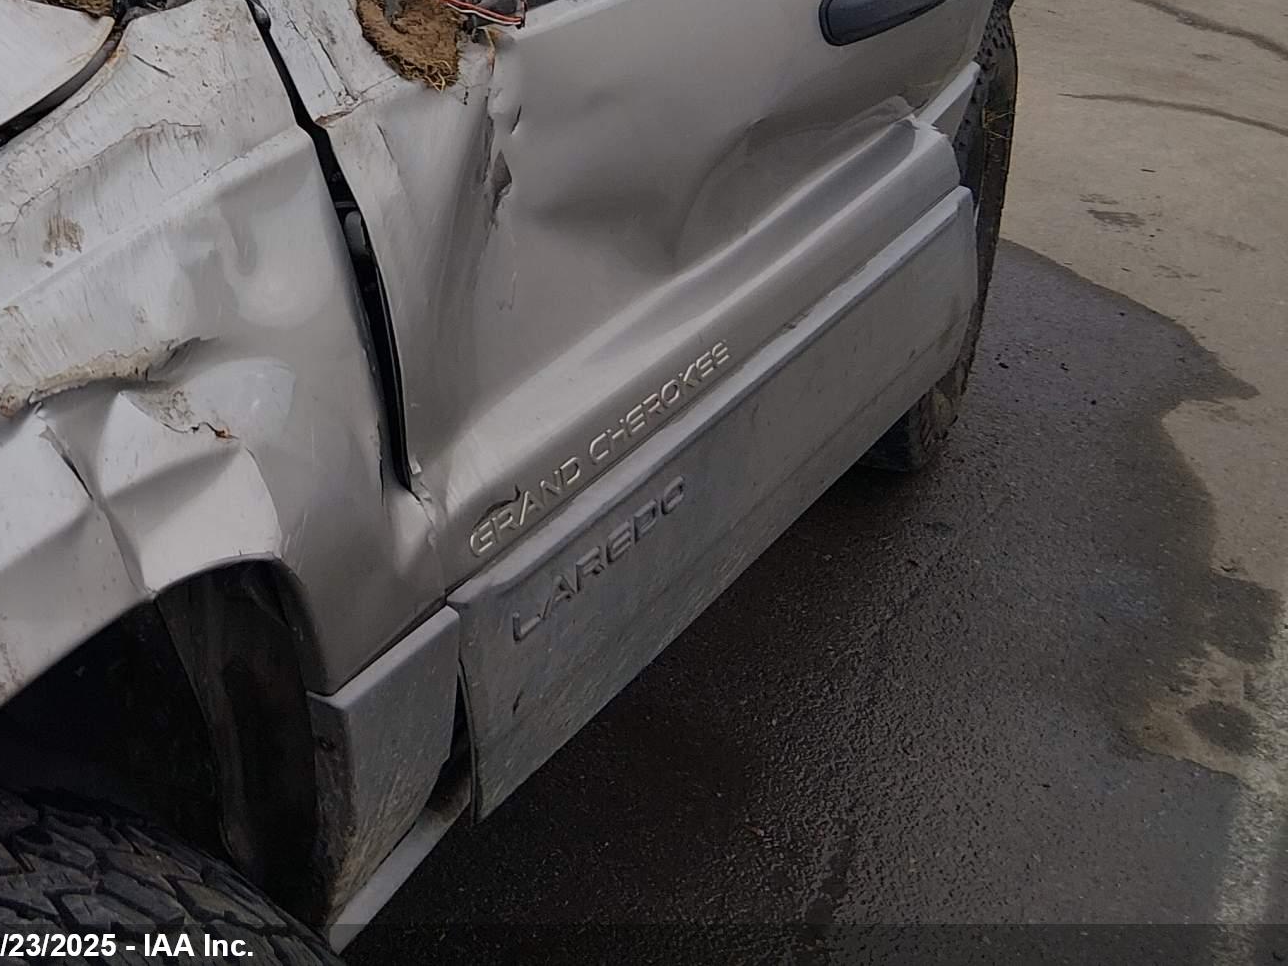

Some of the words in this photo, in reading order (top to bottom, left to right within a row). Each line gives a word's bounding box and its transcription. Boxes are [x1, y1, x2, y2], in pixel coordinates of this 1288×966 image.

[468, 455, 582, 558] GRAND
[588, 339, 732, 466] CHEROKEE
[512, 474, 687, 642] LAREDO
